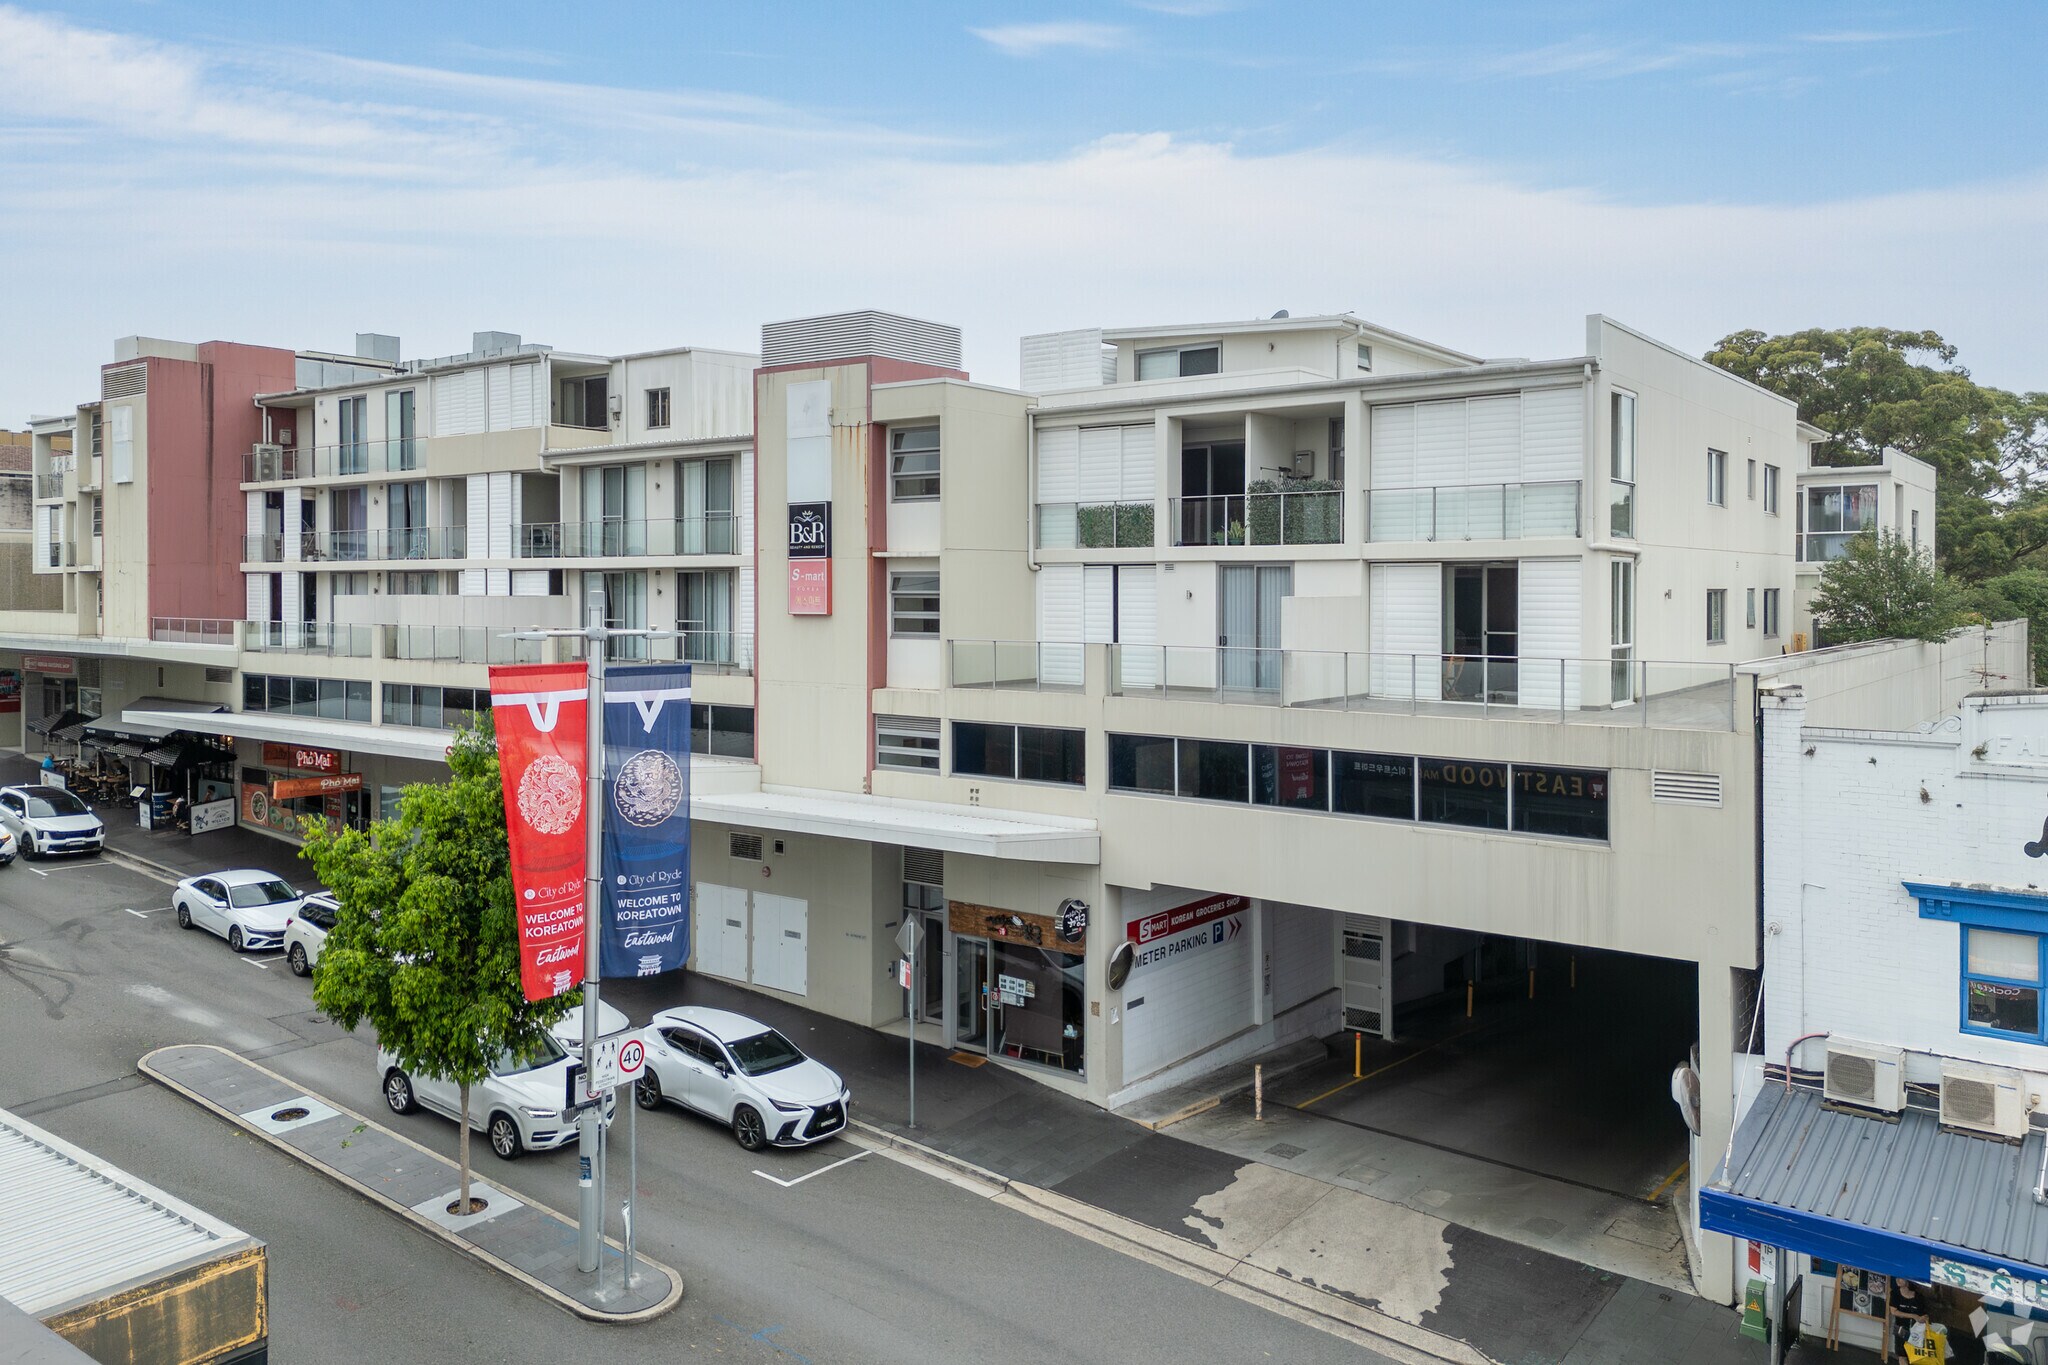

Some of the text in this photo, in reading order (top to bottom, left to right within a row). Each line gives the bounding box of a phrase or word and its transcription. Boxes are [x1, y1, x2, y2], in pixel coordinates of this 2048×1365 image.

[790, 521, 825, 544] B&R
[314, 752, 332, 770] Mai
[629, 869, 682, 887] City of Ryde
[538, 880, 581, 900] City of Ryde
[617, 892, 681, 909] WELCOME TO
[525, 902, 583, 925] WELCOME TO
[617, 903, 682, 922] KOREATOWN
[1171, 911, 1194, 926] KOREAN
[1195, 901, 1225, 918] GROCERIES
[1226, 896, 1240, 909] SHOP
[525, 914, 584, 938] KOREATOWN
[624, 925, 676, 949] Eastwood
[536, 937, 581, 967] Eastwood
[1135, 946, 1166, 969] METER
[1168, 931, 1208, 957] PARKING
[623, 1047, 641, 1064] 40
